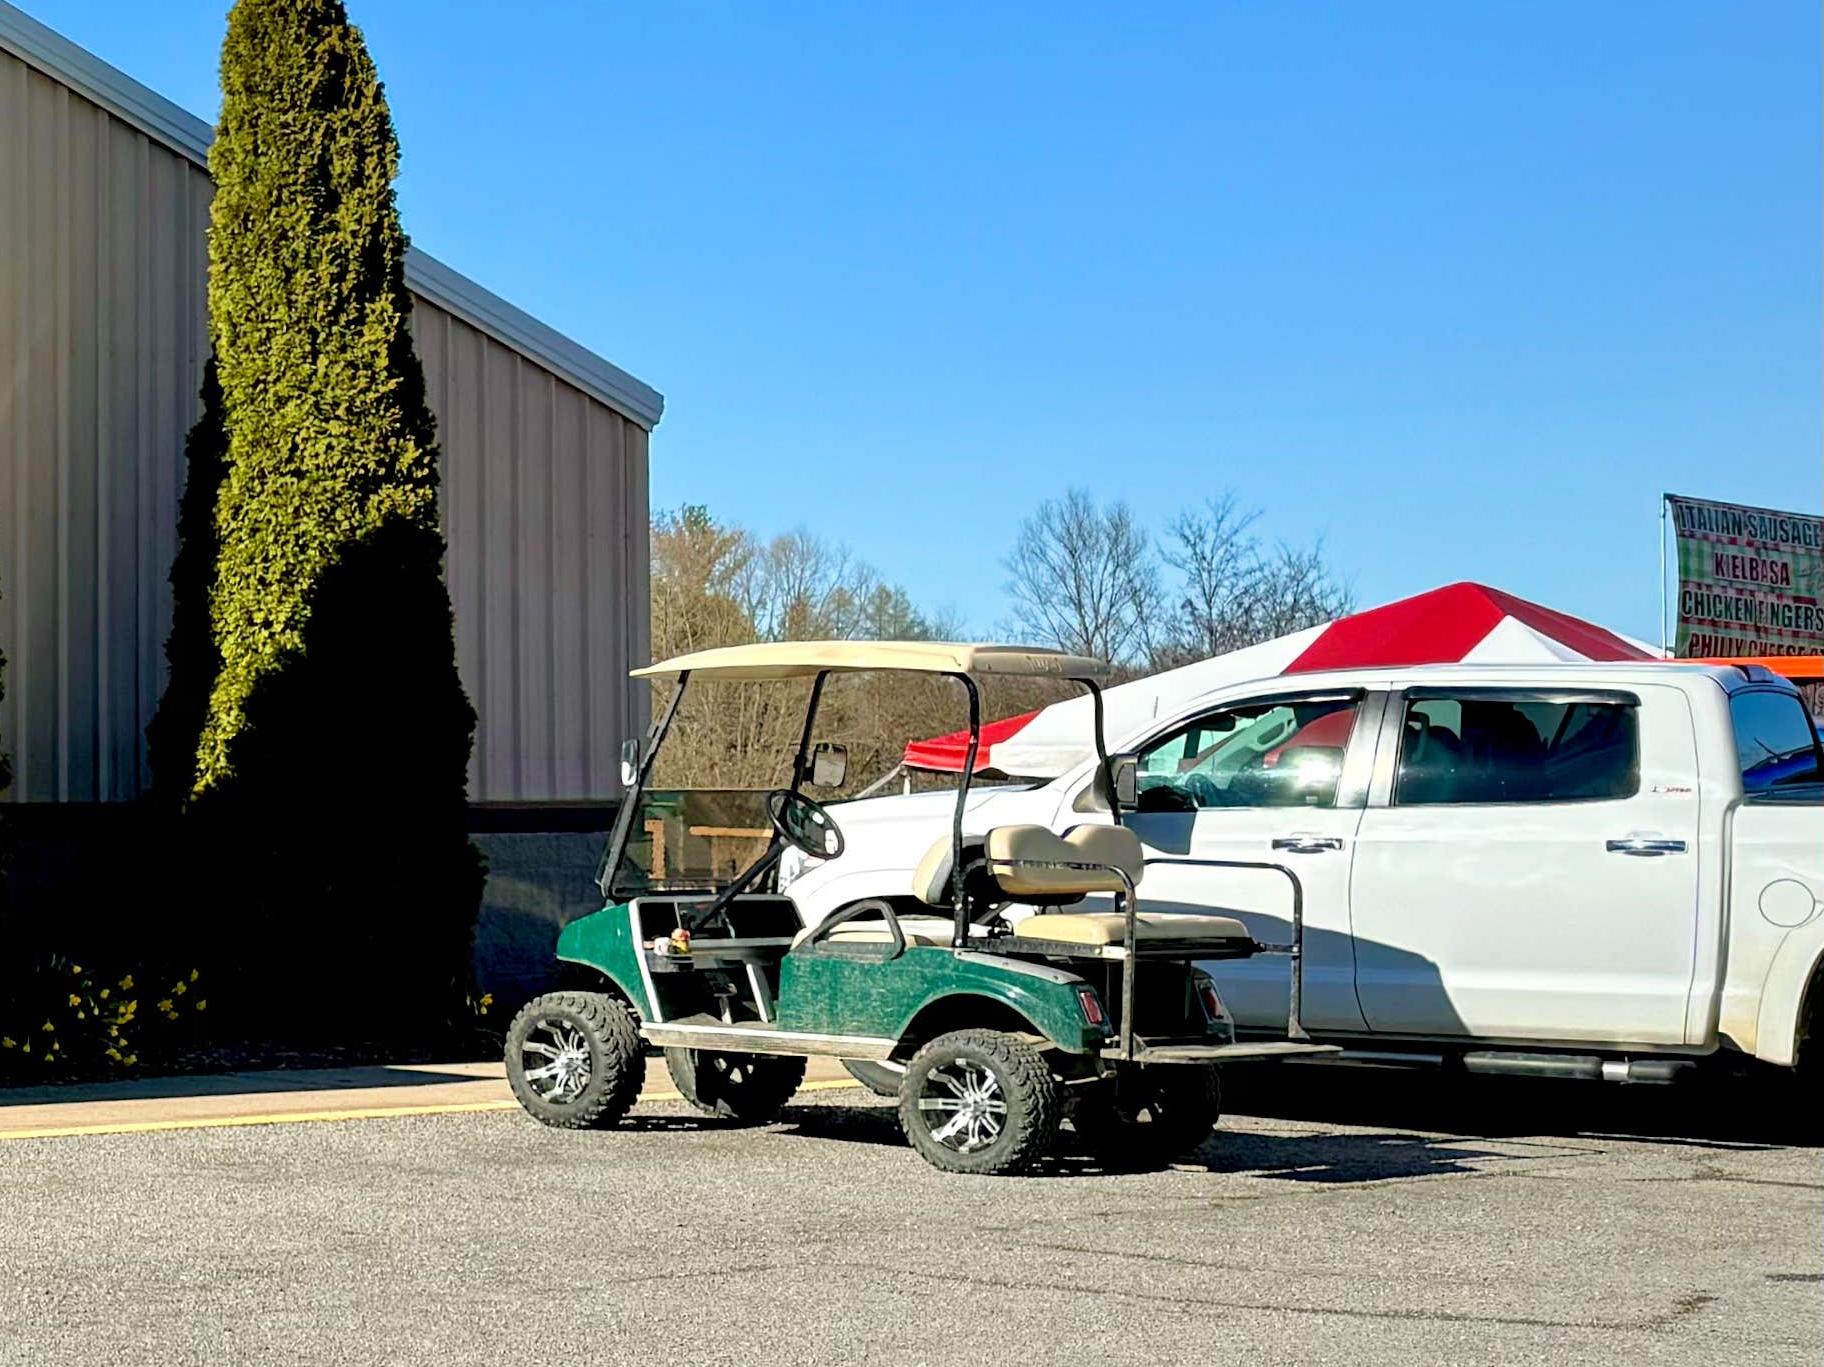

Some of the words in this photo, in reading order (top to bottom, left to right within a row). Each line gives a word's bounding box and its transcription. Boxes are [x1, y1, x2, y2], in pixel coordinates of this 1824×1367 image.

[1678, 504, 1743, 536] ITALIAN
[1747, 514, 1821, 547] SAUSAGE
[1715, 553, 1790, 585] KIELBASA
[1682, 590, 1755, 622] CHICKEN
[1758, 600, 1824, 632] FINGERS
